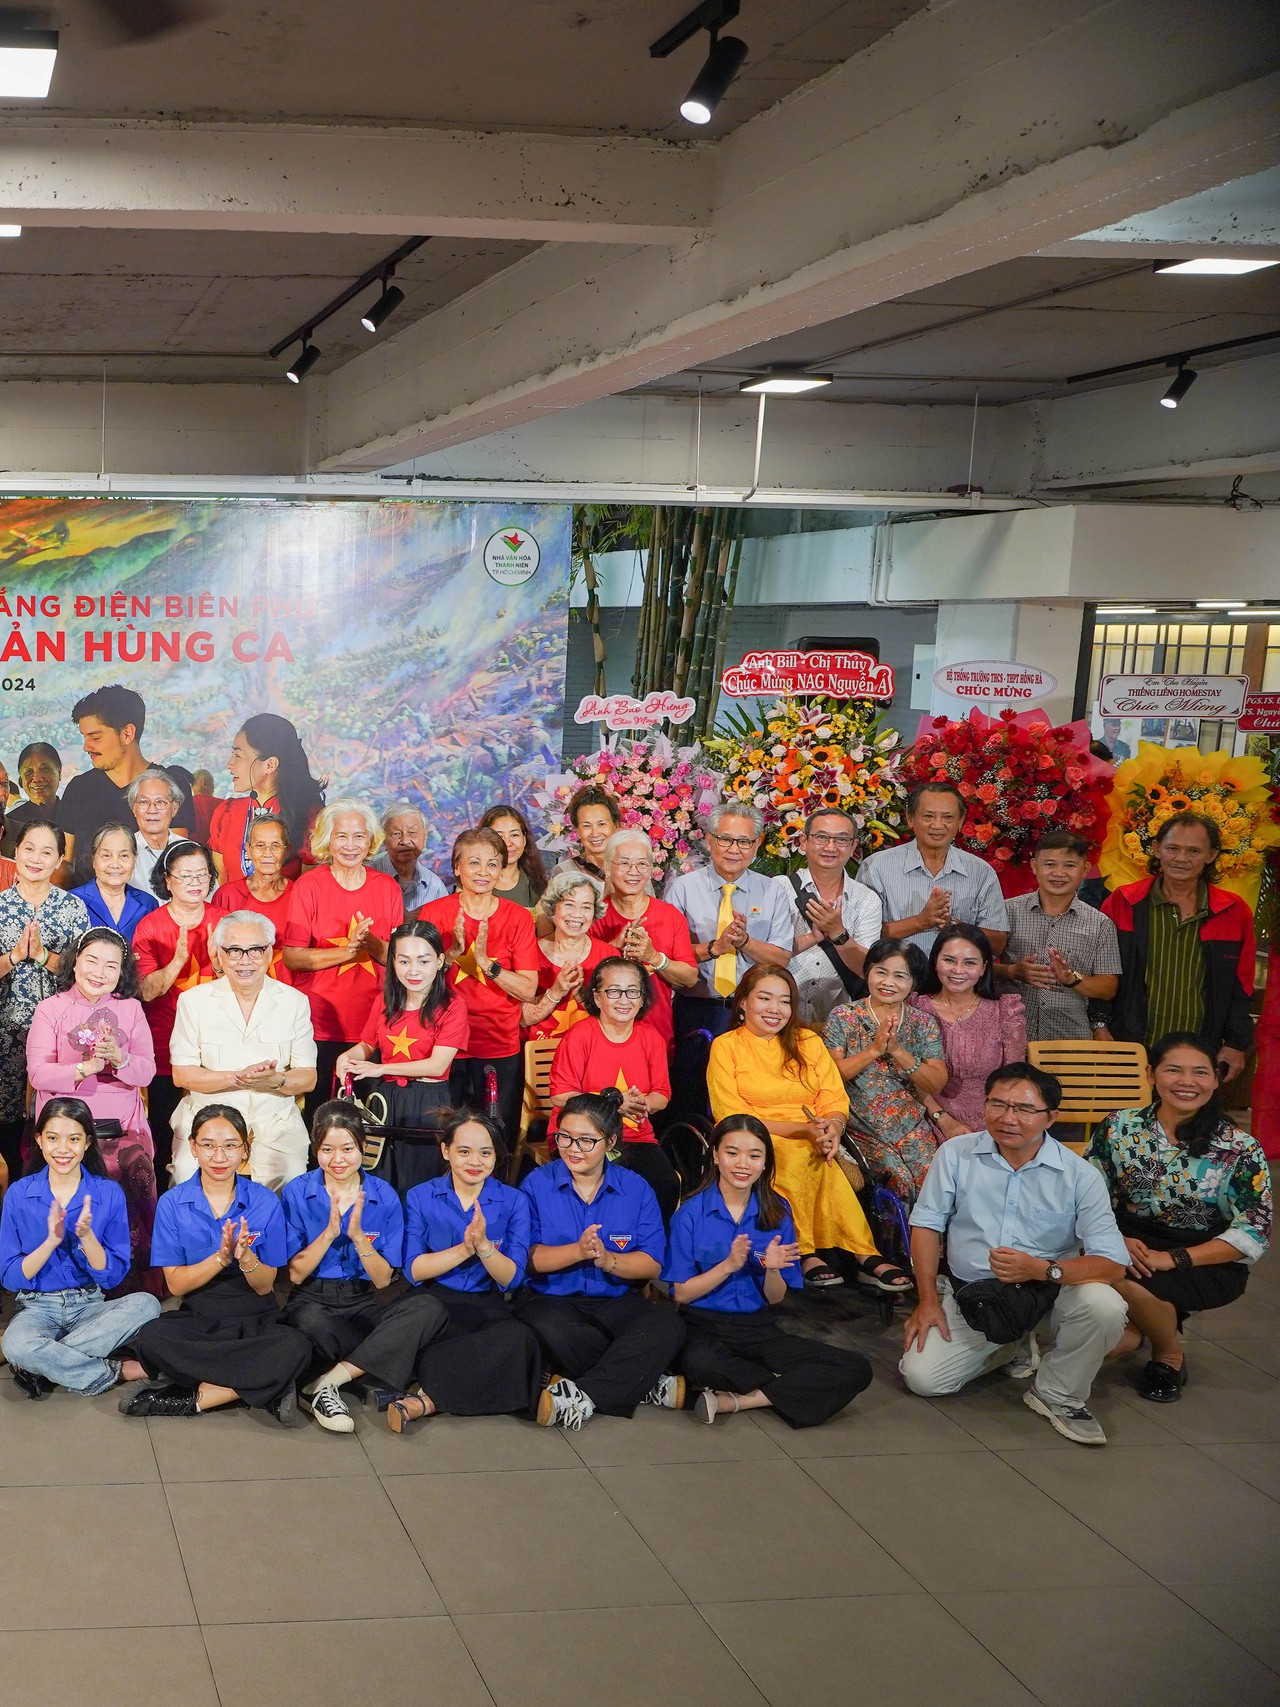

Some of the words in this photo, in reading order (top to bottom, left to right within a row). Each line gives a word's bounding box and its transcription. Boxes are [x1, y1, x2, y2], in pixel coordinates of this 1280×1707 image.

[74, 590, 151, 622] ĐIỆN
[165, 591, 238, 618] BIÊN
[84, 625, 215, 663] HÙNG
[231, 630, 295, 663] CA
[748, 656, 773, 669] Anh
[777, 655, 797, 668] Bill
[809, 656, 831, 671] Chị
[835, 655, 867, 673] Thủy
[728, 674, 758, 691] Chúc
[760, 672, 794, 692] Mừng
[797, 673, 825, 690] NAG
[828, 673, 874, 695] Nguyễn
[876, 673, 888, 694] Á
[954, 668, 970, 682] THỐNG
[970, 670, 990, 683] TRƯỜNG
[991, 673, 1004, 683] THCS
[1007, 673, 1020, 684] THPT
[1020, 669, 1035, 685] HỒNG
[1035, 672, 1043, 684] HÀ
[956, 684, 991, 696] CHÚC
[993, 685, 1032, 698] MỪNG
[1114, 698, 1159, 711] Chúc
